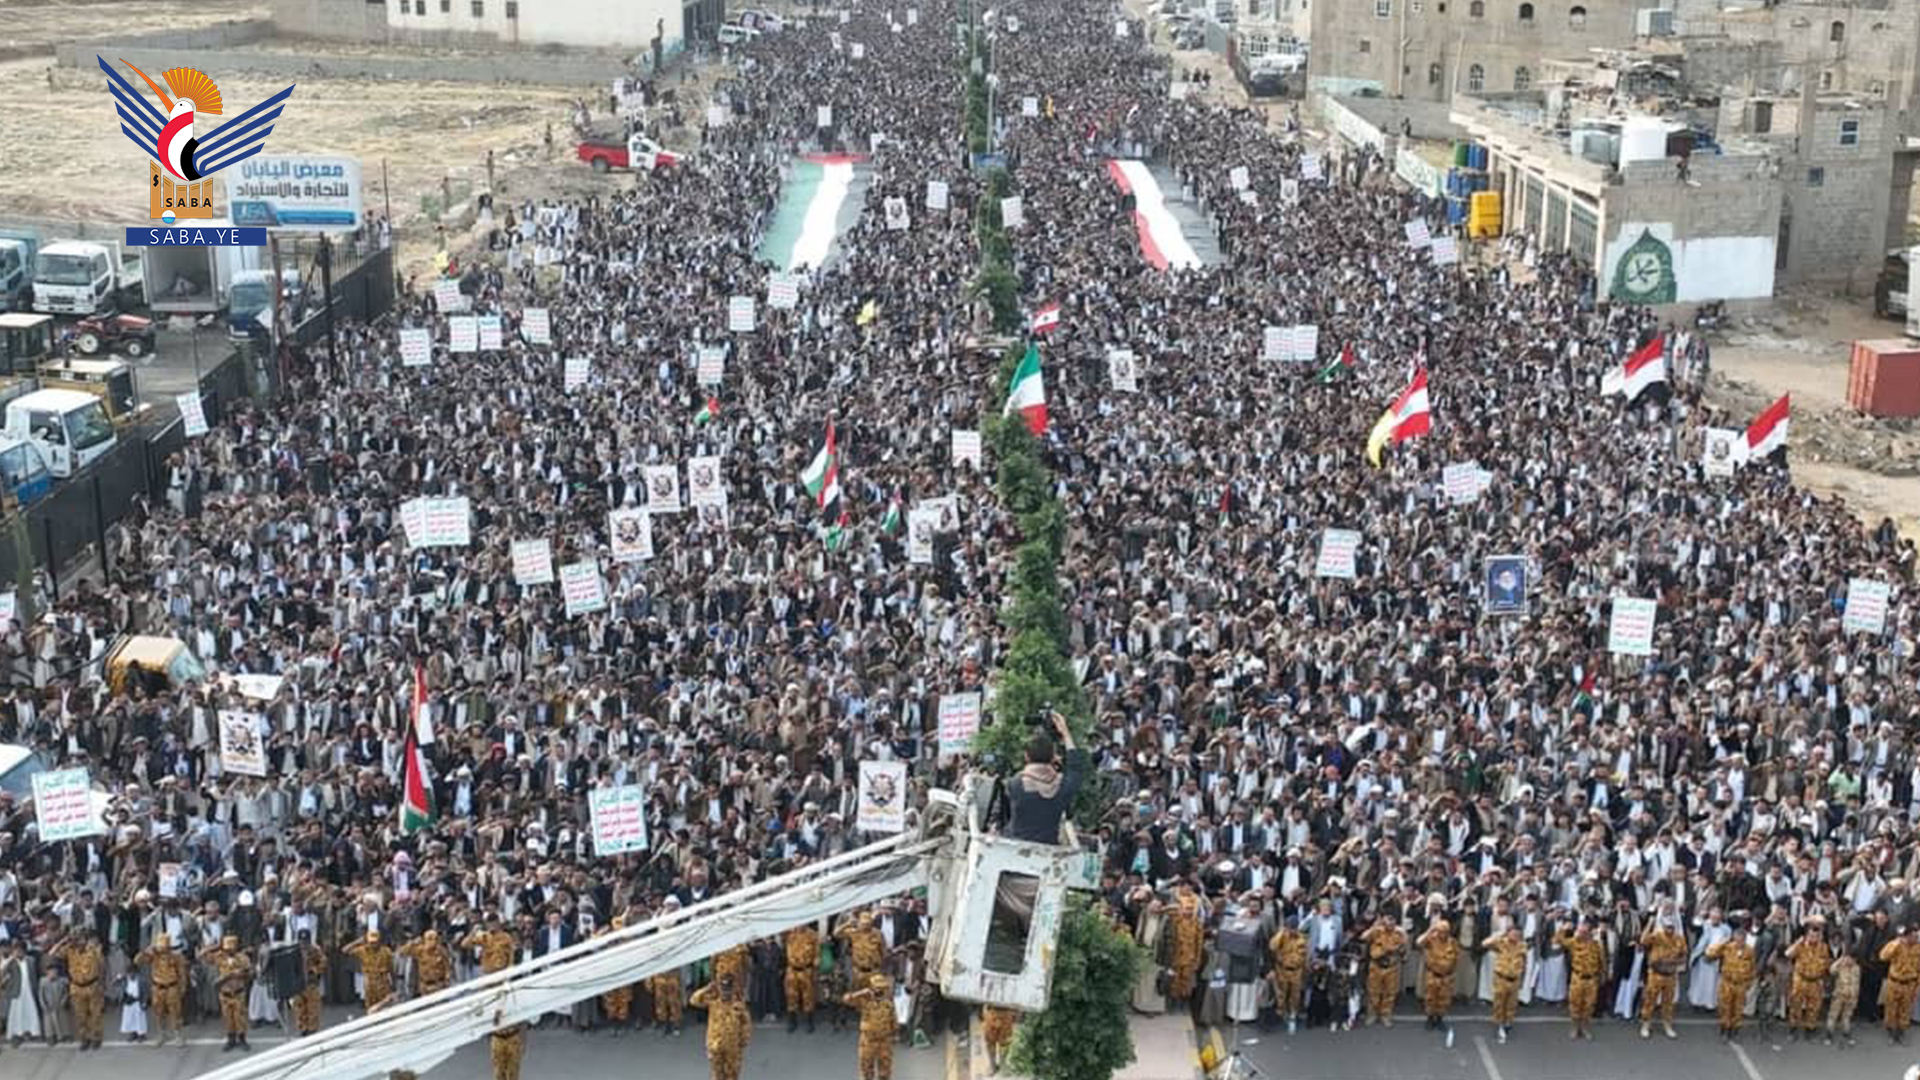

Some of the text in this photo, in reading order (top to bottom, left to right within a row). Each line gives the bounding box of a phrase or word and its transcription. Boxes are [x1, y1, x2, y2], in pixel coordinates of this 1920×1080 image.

[293, 163, 344, 180] معرض
[236, 180, 349, 200] للتجارة والاستيراد
